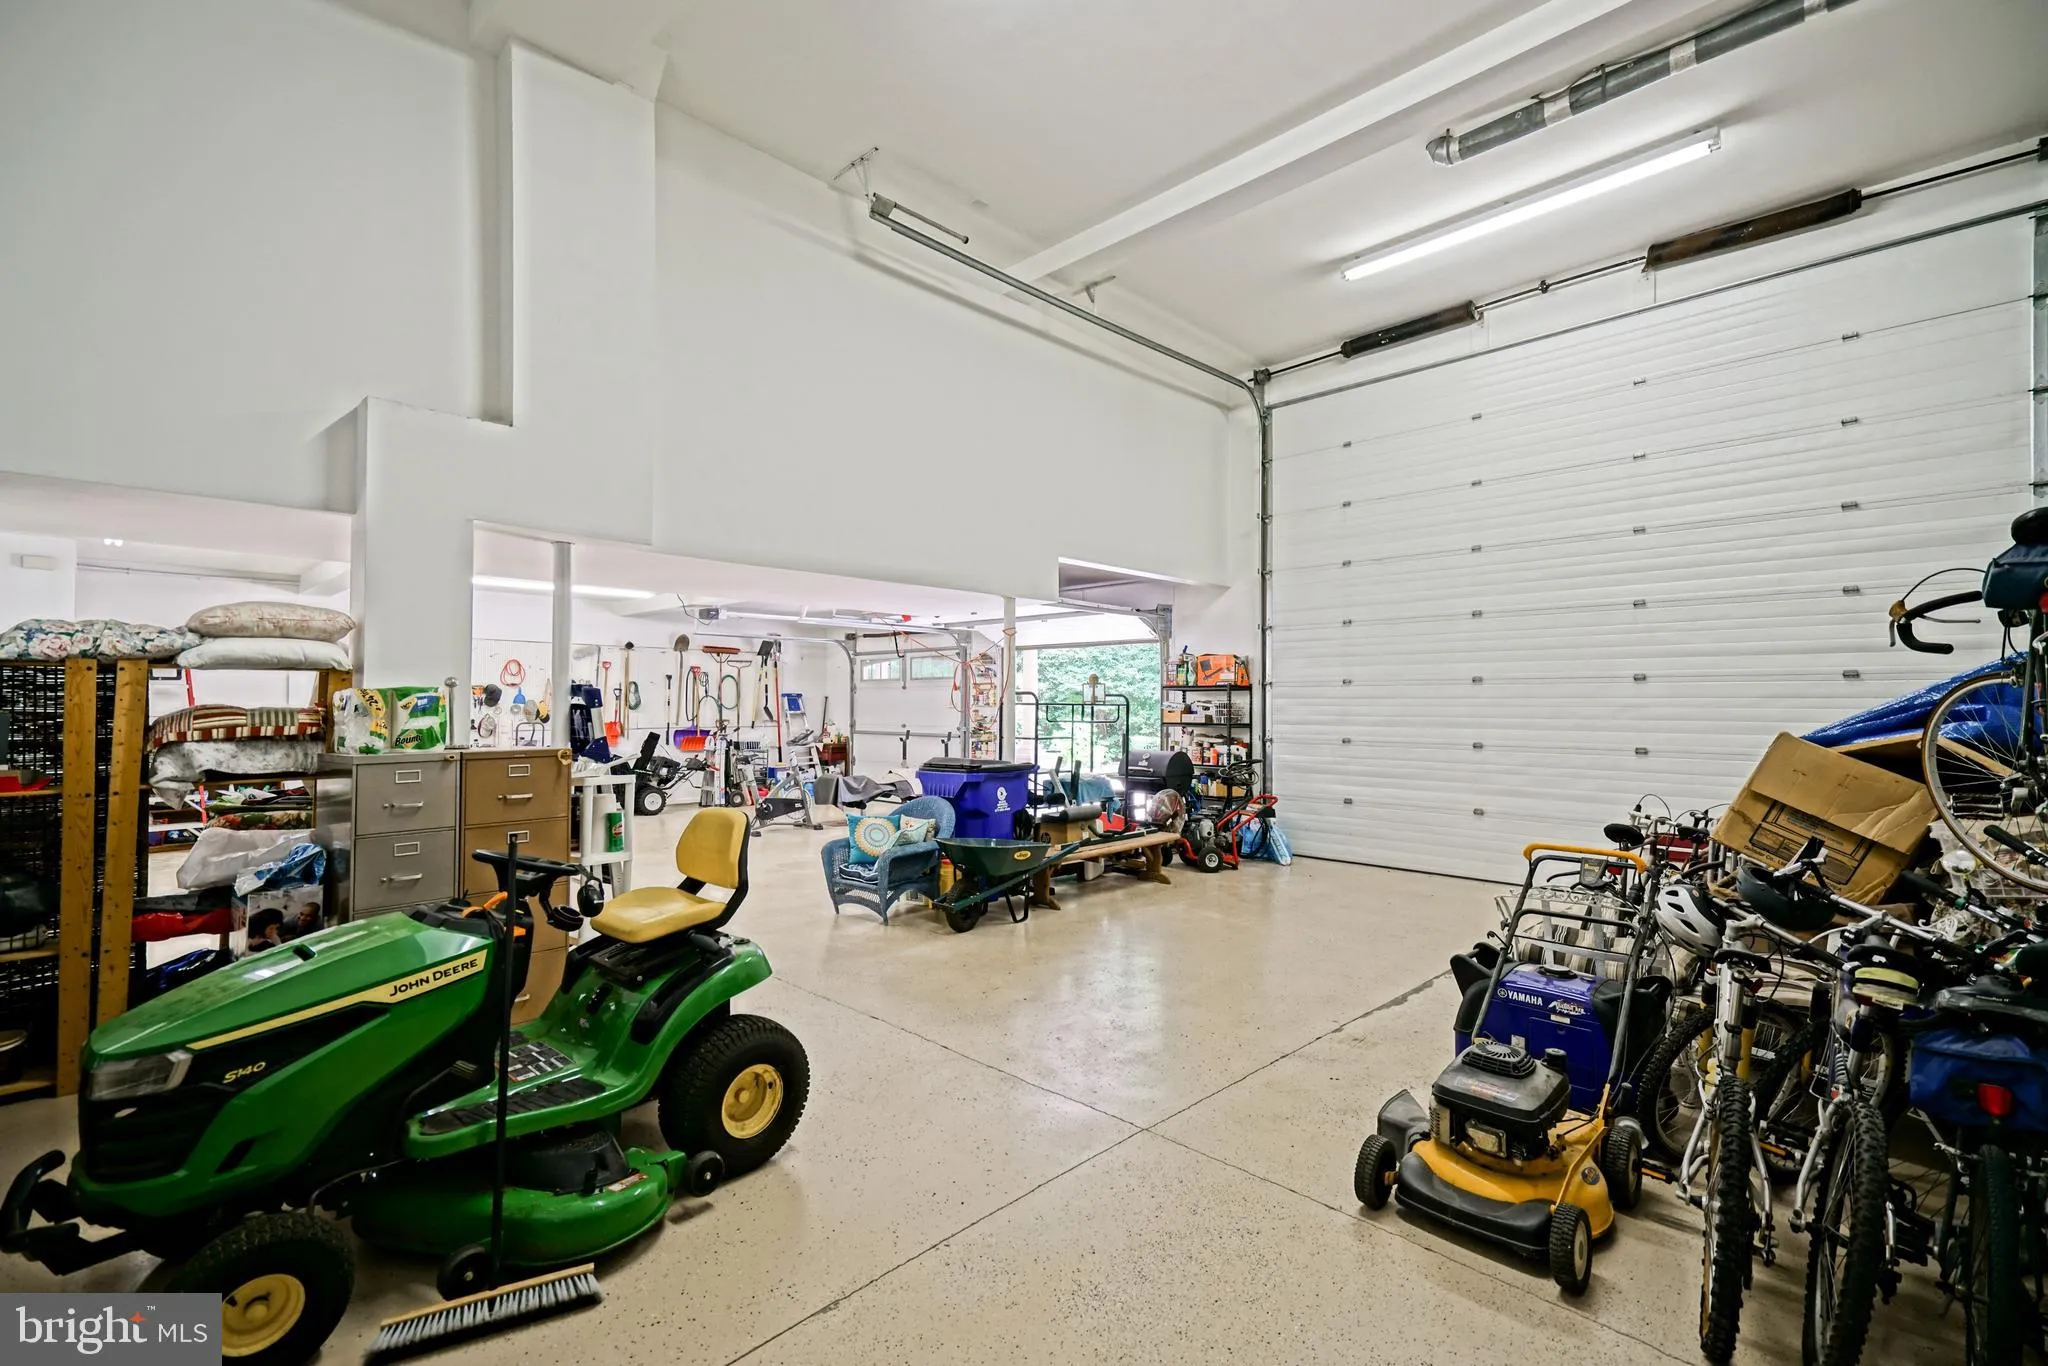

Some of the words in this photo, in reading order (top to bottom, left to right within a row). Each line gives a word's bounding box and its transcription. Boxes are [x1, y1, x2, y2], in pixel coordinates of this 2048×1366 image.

[394, 734, 423, 747] Bounty
[432, 959, 478, 982] DEERE
[1508, 990, 1543, 1006] YAMAHA
[222, 1062, 266, 1084] S140
